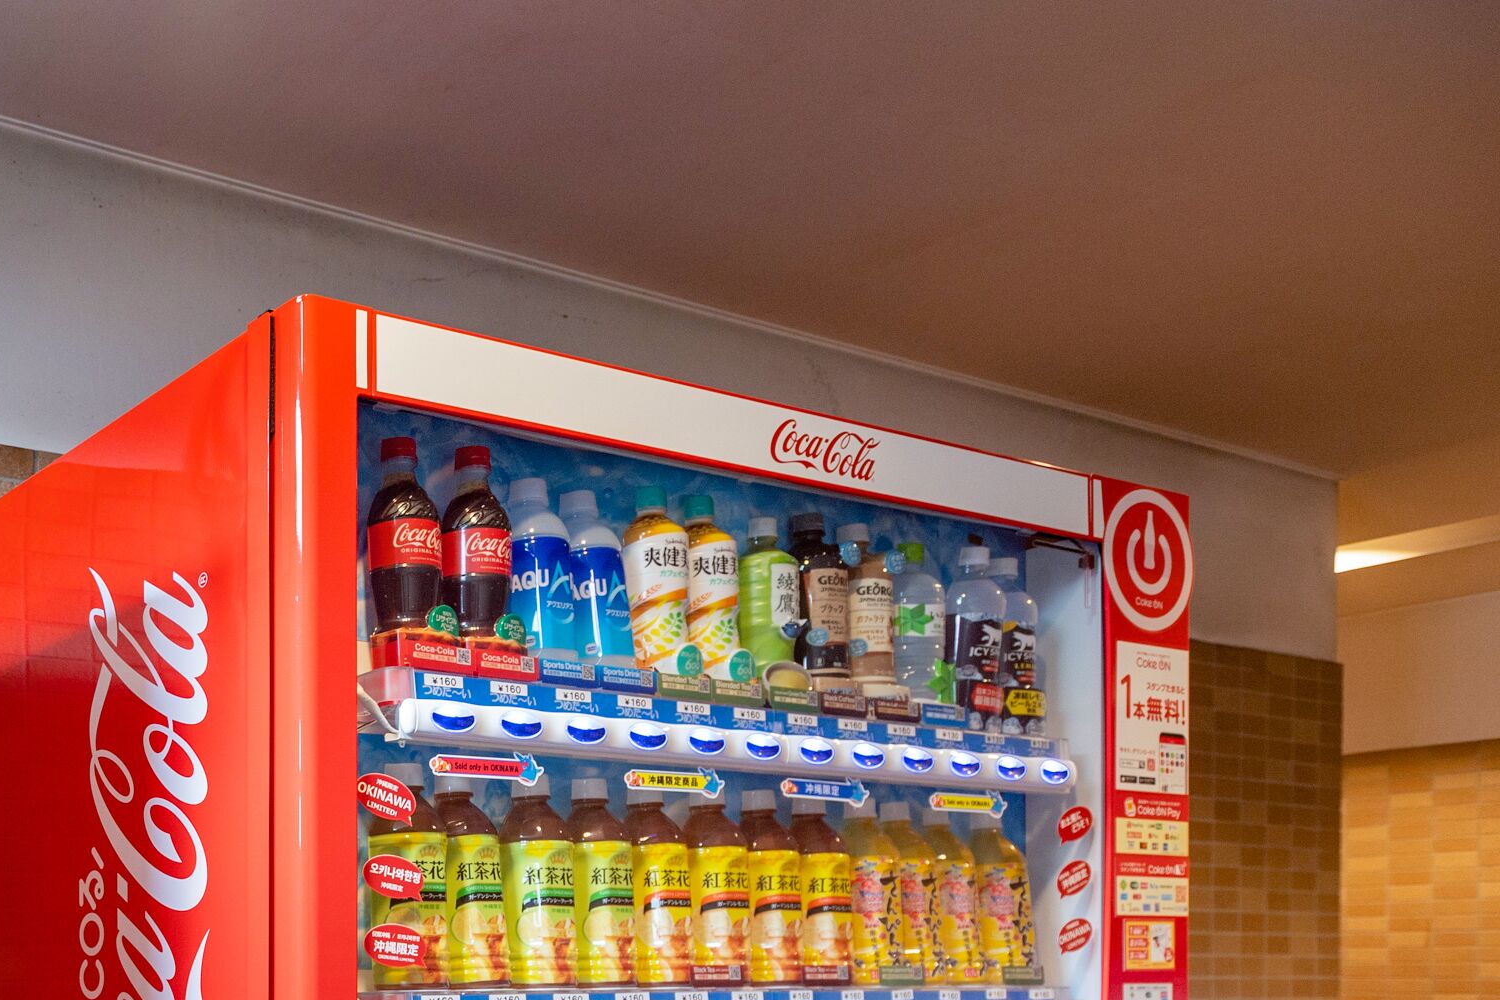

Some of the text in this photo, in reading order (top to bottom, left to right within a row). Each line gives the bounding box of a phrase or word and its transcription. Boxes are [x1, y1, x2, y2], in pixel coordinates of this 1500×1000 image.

[770, 419, 880, 481] Coca-Cola
[775, 572, 795, 615] 綾鷹
[857, 582, 893, 596] GEORG
[415, 643, 455, 656] Coca-Cola
[482, 653, 519, 664] Coca-Cola
[543, 660, 582, 671] Sports Drink
[604, 667, 641, 677] Sports Drink
[432, 676, 457, 687] ¥160
[498, 684, 521, 694] ¥160
[564, 692, 585, 701] ¥160
[625, 698, 647, 707] ¥160
[684, 705, 705, 713] ¥160
[741, 711, 760, 719] ¥160
[794, 717, 813, 725] ¥160
[844, 721, 863, 730] ¥160
[455, 762, 519, 773] Sold only in OKINAWA
[648, 775, 699, 787] 沖縄限定商品
[357, 781, 412, 811] OKINAWA
[367, 800, 398, 817] LIMITED!
[644, 869, 690, 887] 紅茶花
[701, 871, 748, 889] 紅茶花
[755, 874, 800, 892] 紅茶花
[808, 877, 852, 894] 紅茶花
[1059, 924, 1091, 946] OKINAWA
[373, 940, 419, 957] 沖縄限定
[682, 993, 703, 1000] ¥160
[738, 993, 758, 1000] ¥160
[792, 992, 810, 1000] ¥160
[844, 992, 861, 1000] ¥160
[894, 992, 911, 1000] ¥160
